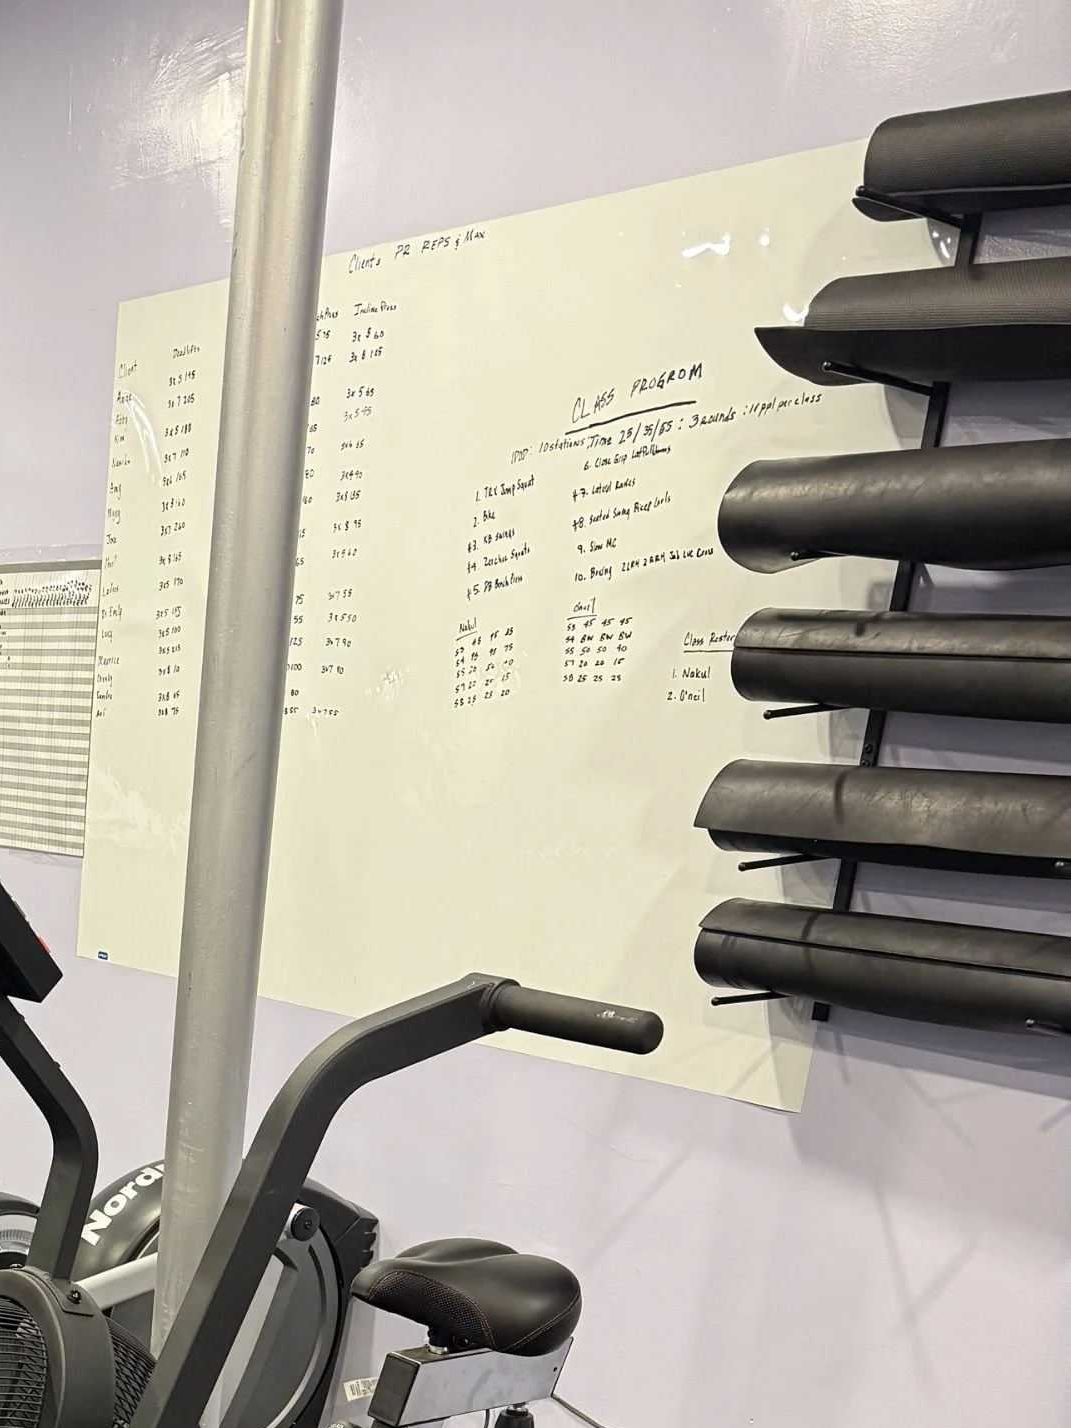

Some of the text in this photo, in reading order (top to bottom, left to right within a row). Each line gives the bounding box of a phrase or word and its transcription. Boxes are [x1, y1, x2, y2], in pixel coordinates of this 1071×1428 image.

[349, 254, 381, 273] Clients
[394, 244, 410, 259] PR
[421, 236, 451, 253] REPS
[572, 388, 616, 424] CLASS
[81, 1164, 165, 1246] Nord
